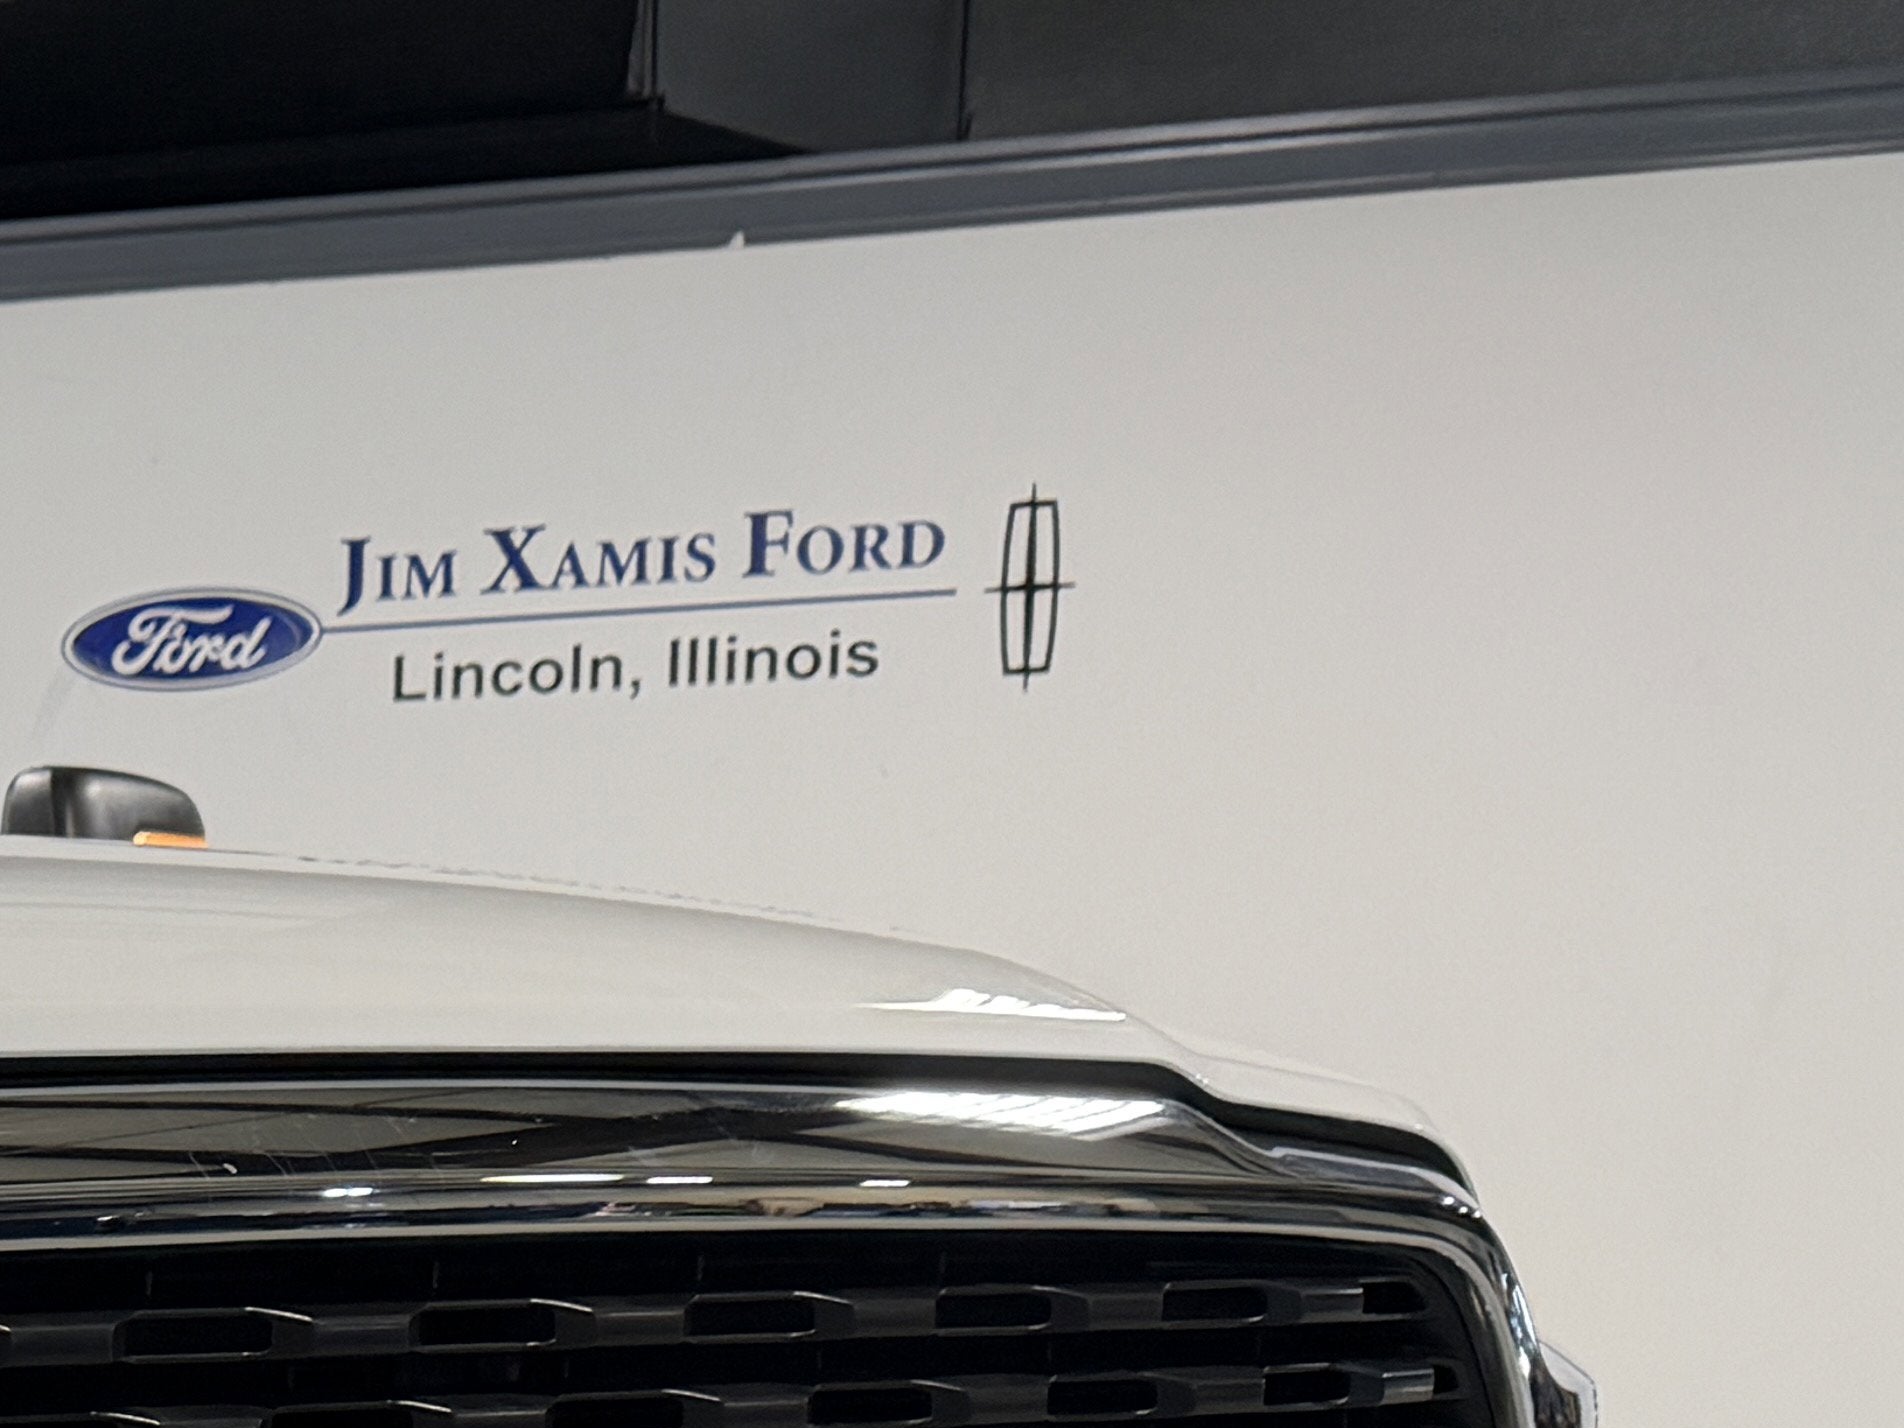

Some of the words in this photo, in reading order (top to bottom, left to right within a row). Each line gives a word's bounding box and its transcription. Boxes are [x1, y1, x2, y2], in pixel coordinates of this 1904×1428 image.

[110, 603, 273, 676] Ford
[392, 643, 641, 703] Lincoln,
[668, 628, 880, 688] Illinois
